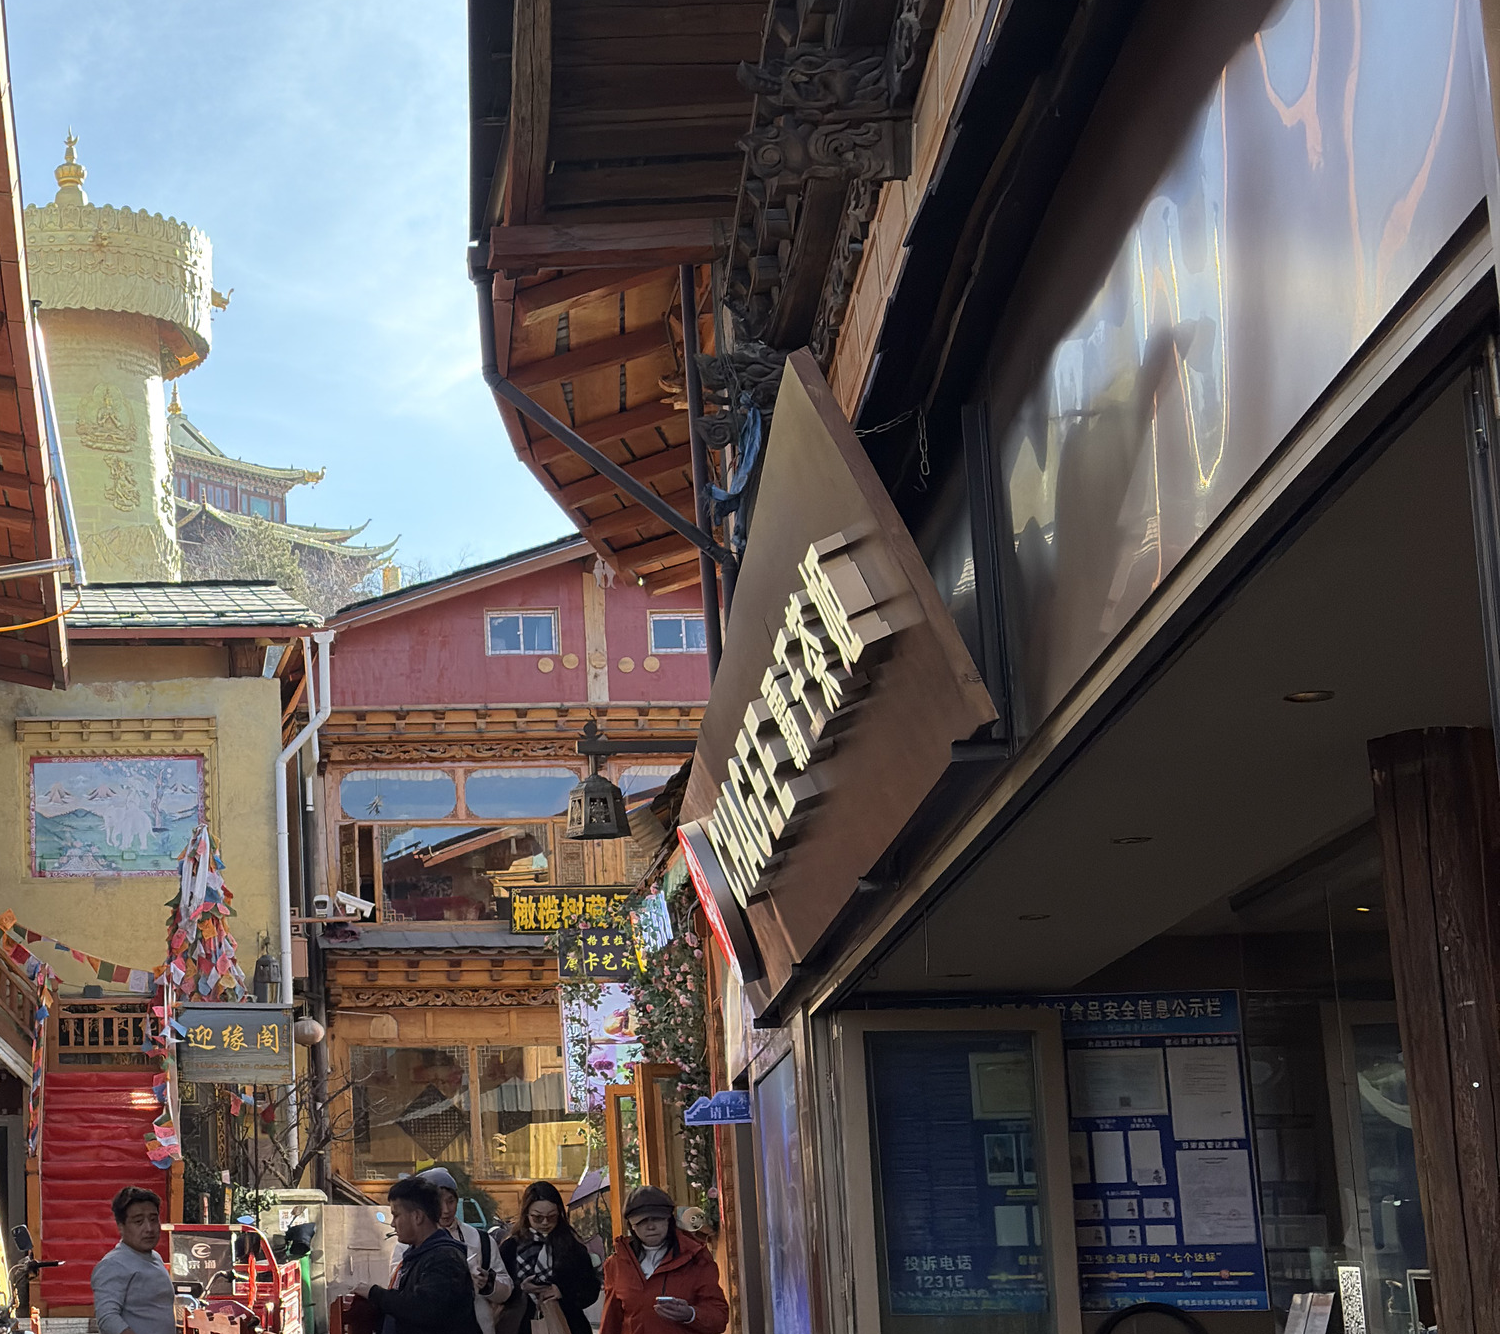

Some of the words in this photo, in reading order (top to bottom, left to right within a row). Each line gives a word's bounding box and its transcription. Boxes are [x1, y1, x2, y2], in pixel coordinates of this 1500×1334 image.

[708, 702, 796, 908] CHAGEE
[187, 1023, 279, 1054] 迎缘阁
[904, 1255, 972, 1272] 投诉电话
[915, 1275, 965, 1289] 12315
